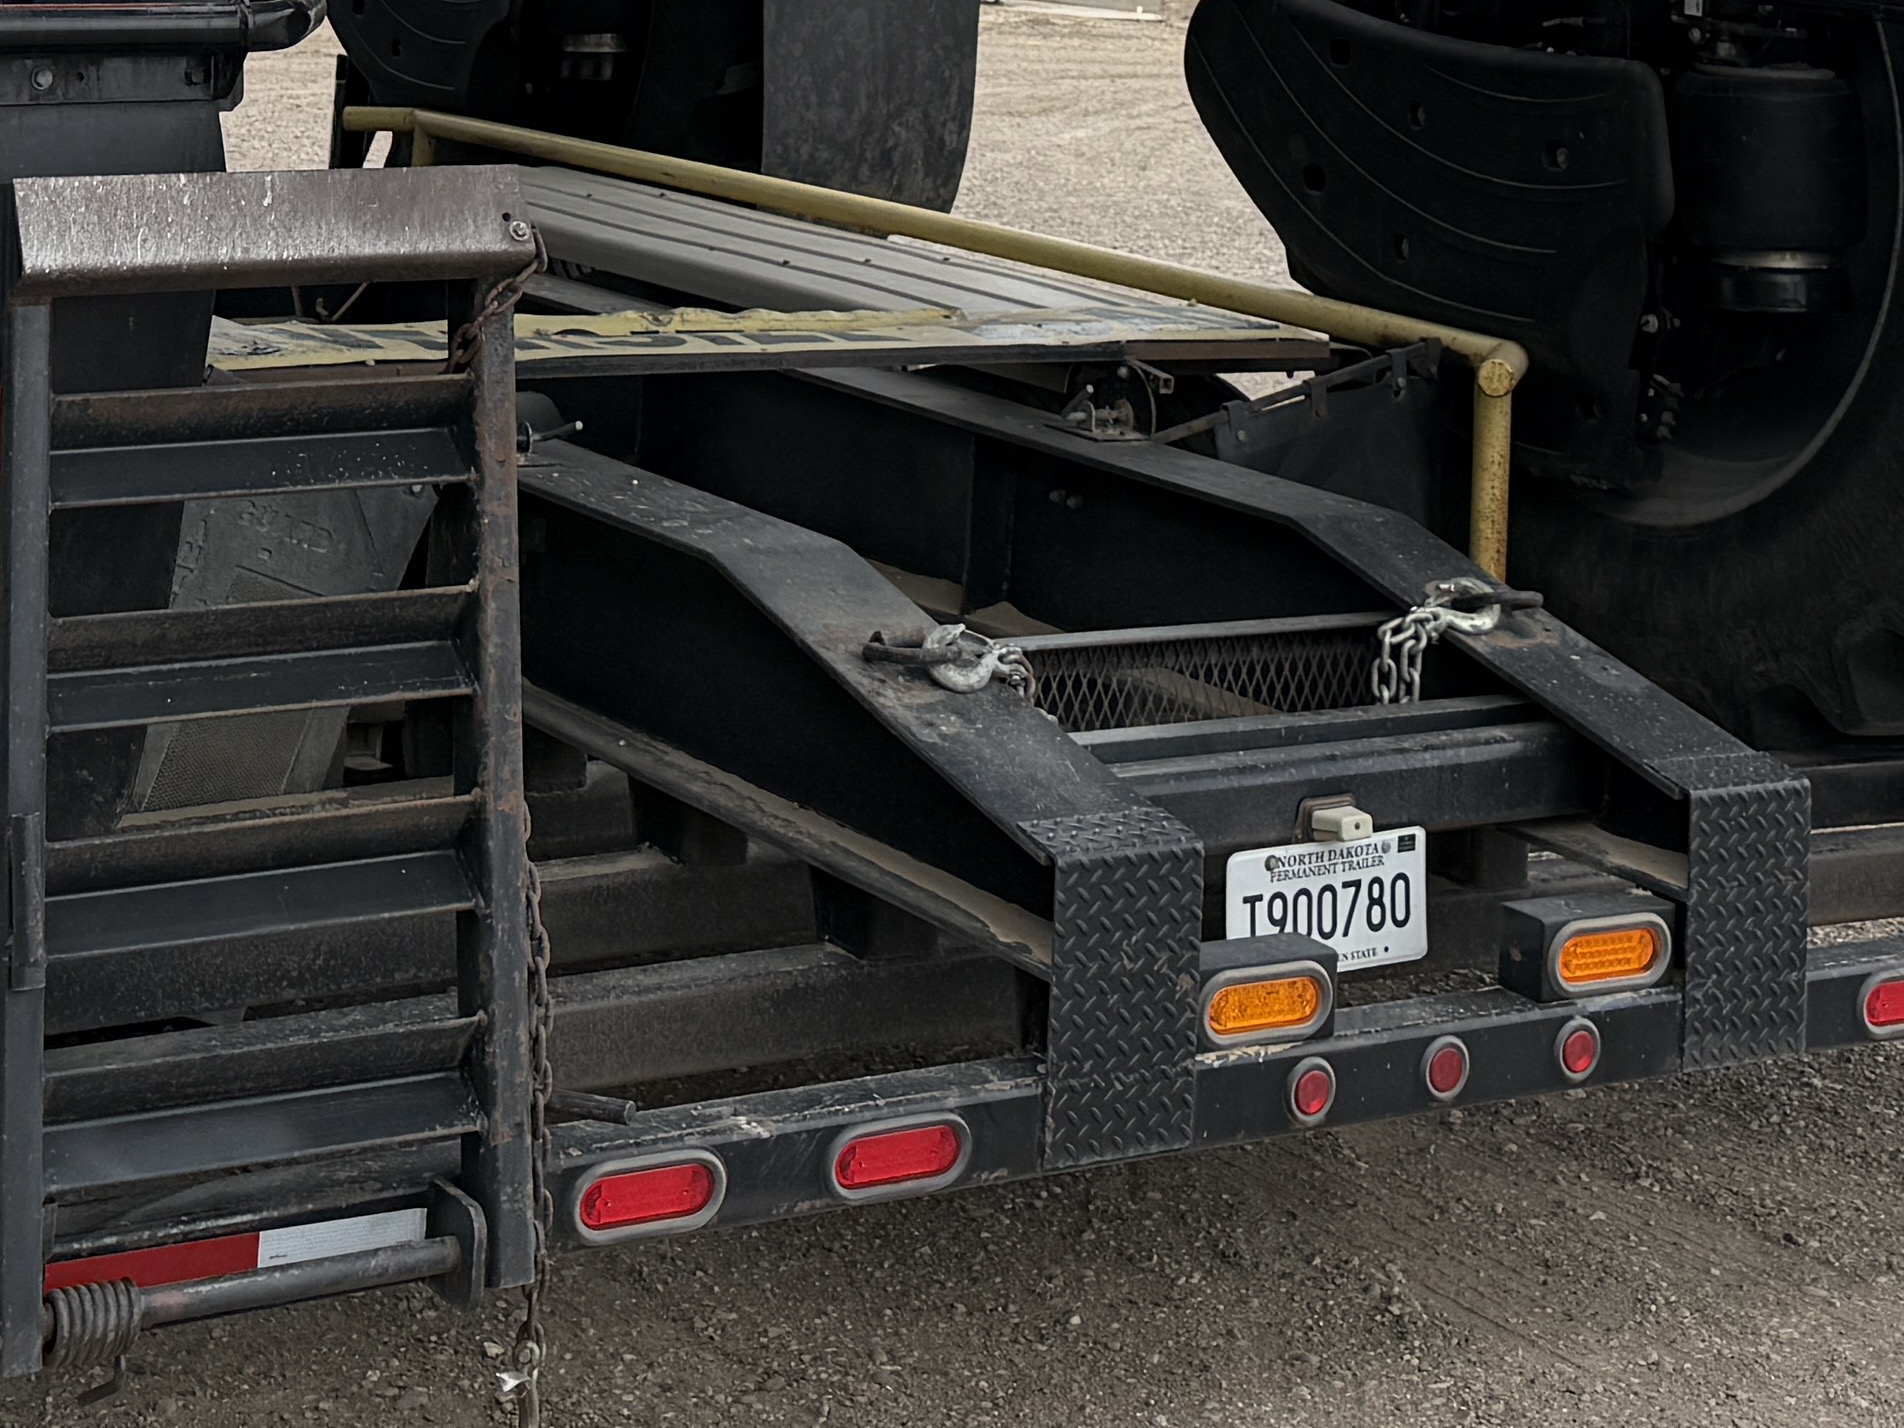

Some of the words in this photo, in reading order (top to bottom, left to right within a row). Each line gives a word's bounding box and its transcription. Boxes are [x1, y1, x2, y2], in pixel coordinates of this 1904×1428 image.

[1270, 863, 1338, 884] PERMANENT
[1341, 854, 1385, 872] TRAILER
[1278, 850, 1325, 869] NORTH
[1327, 842, 1380, 863] DAKOTA
[1242, 871, 1412, 941] T900780
